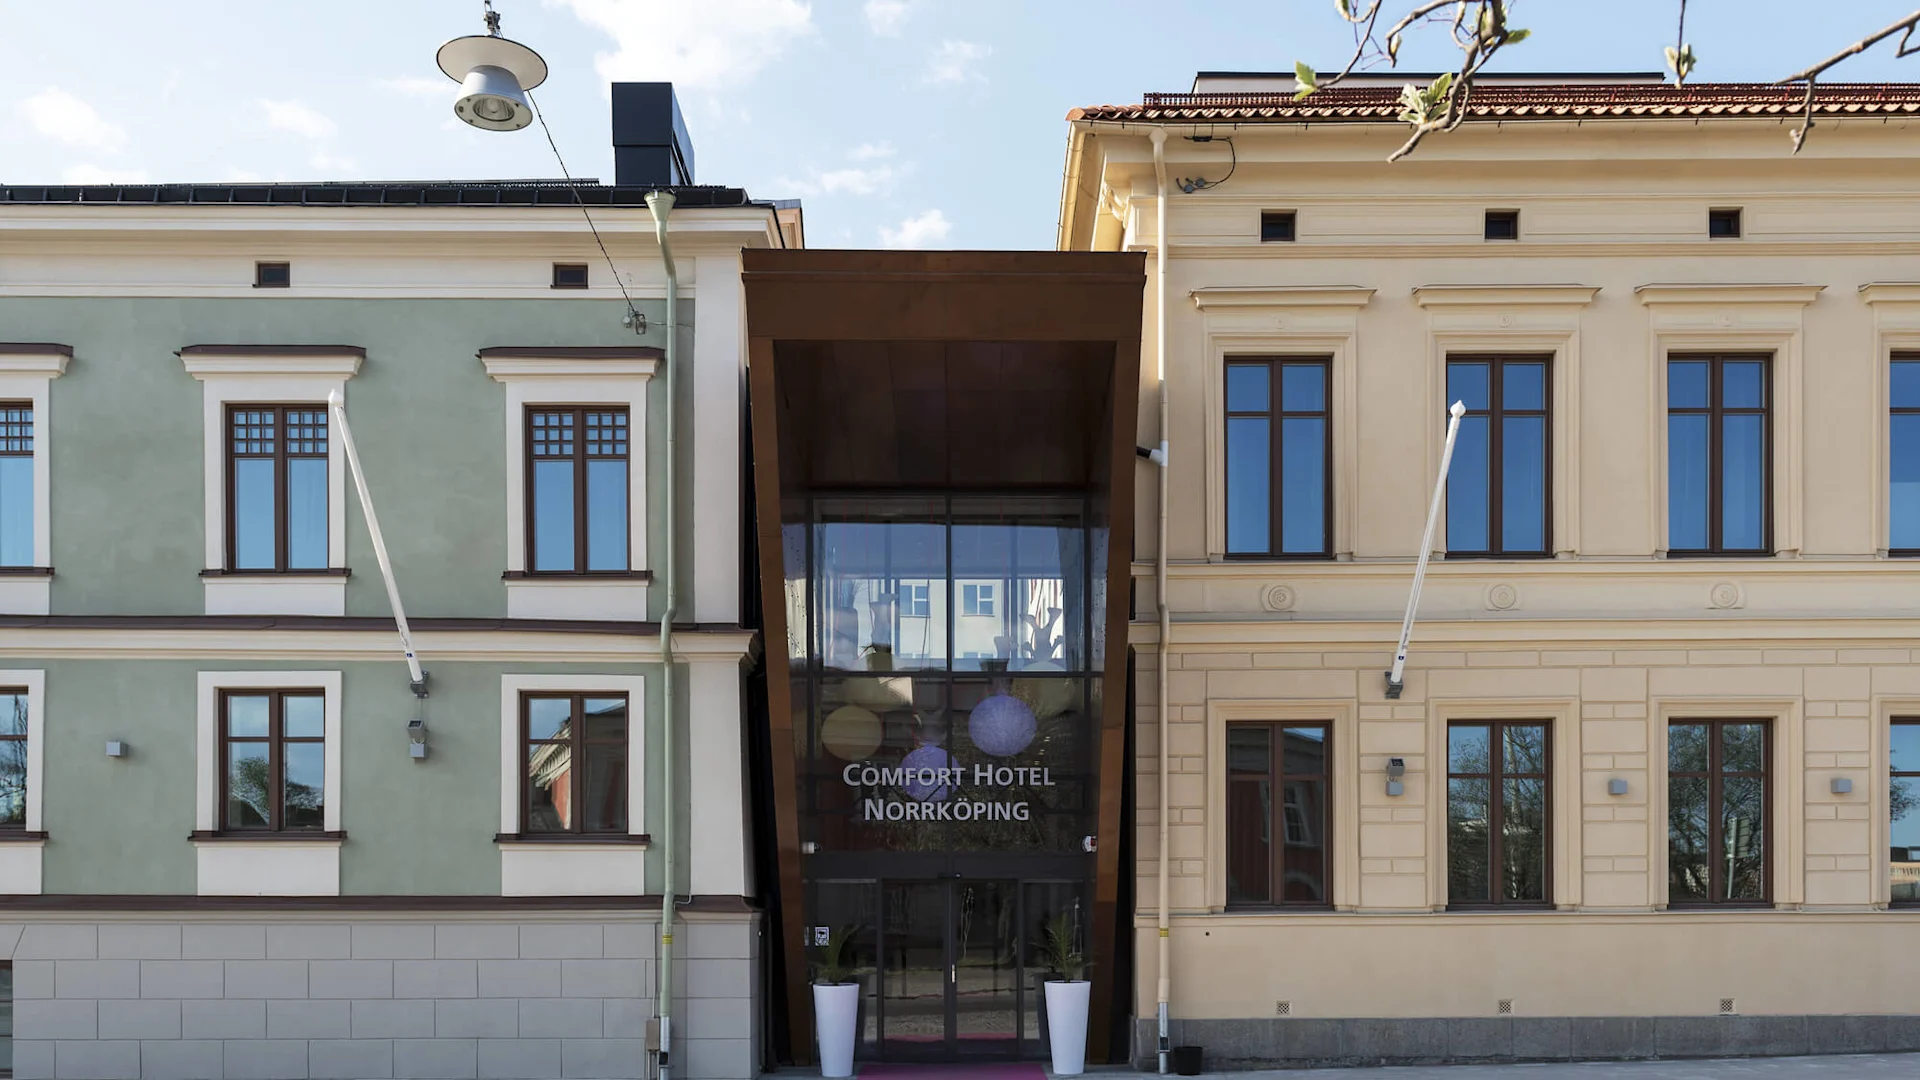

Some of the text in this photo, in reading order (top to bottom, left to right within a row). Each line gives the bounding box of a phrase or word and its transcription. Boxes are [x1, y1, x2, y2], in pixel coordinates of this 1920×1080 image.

[843, 763, 1055, 786] COMFORT HOTEL
[865, 797, 1029, 821] NORRKÖPING
